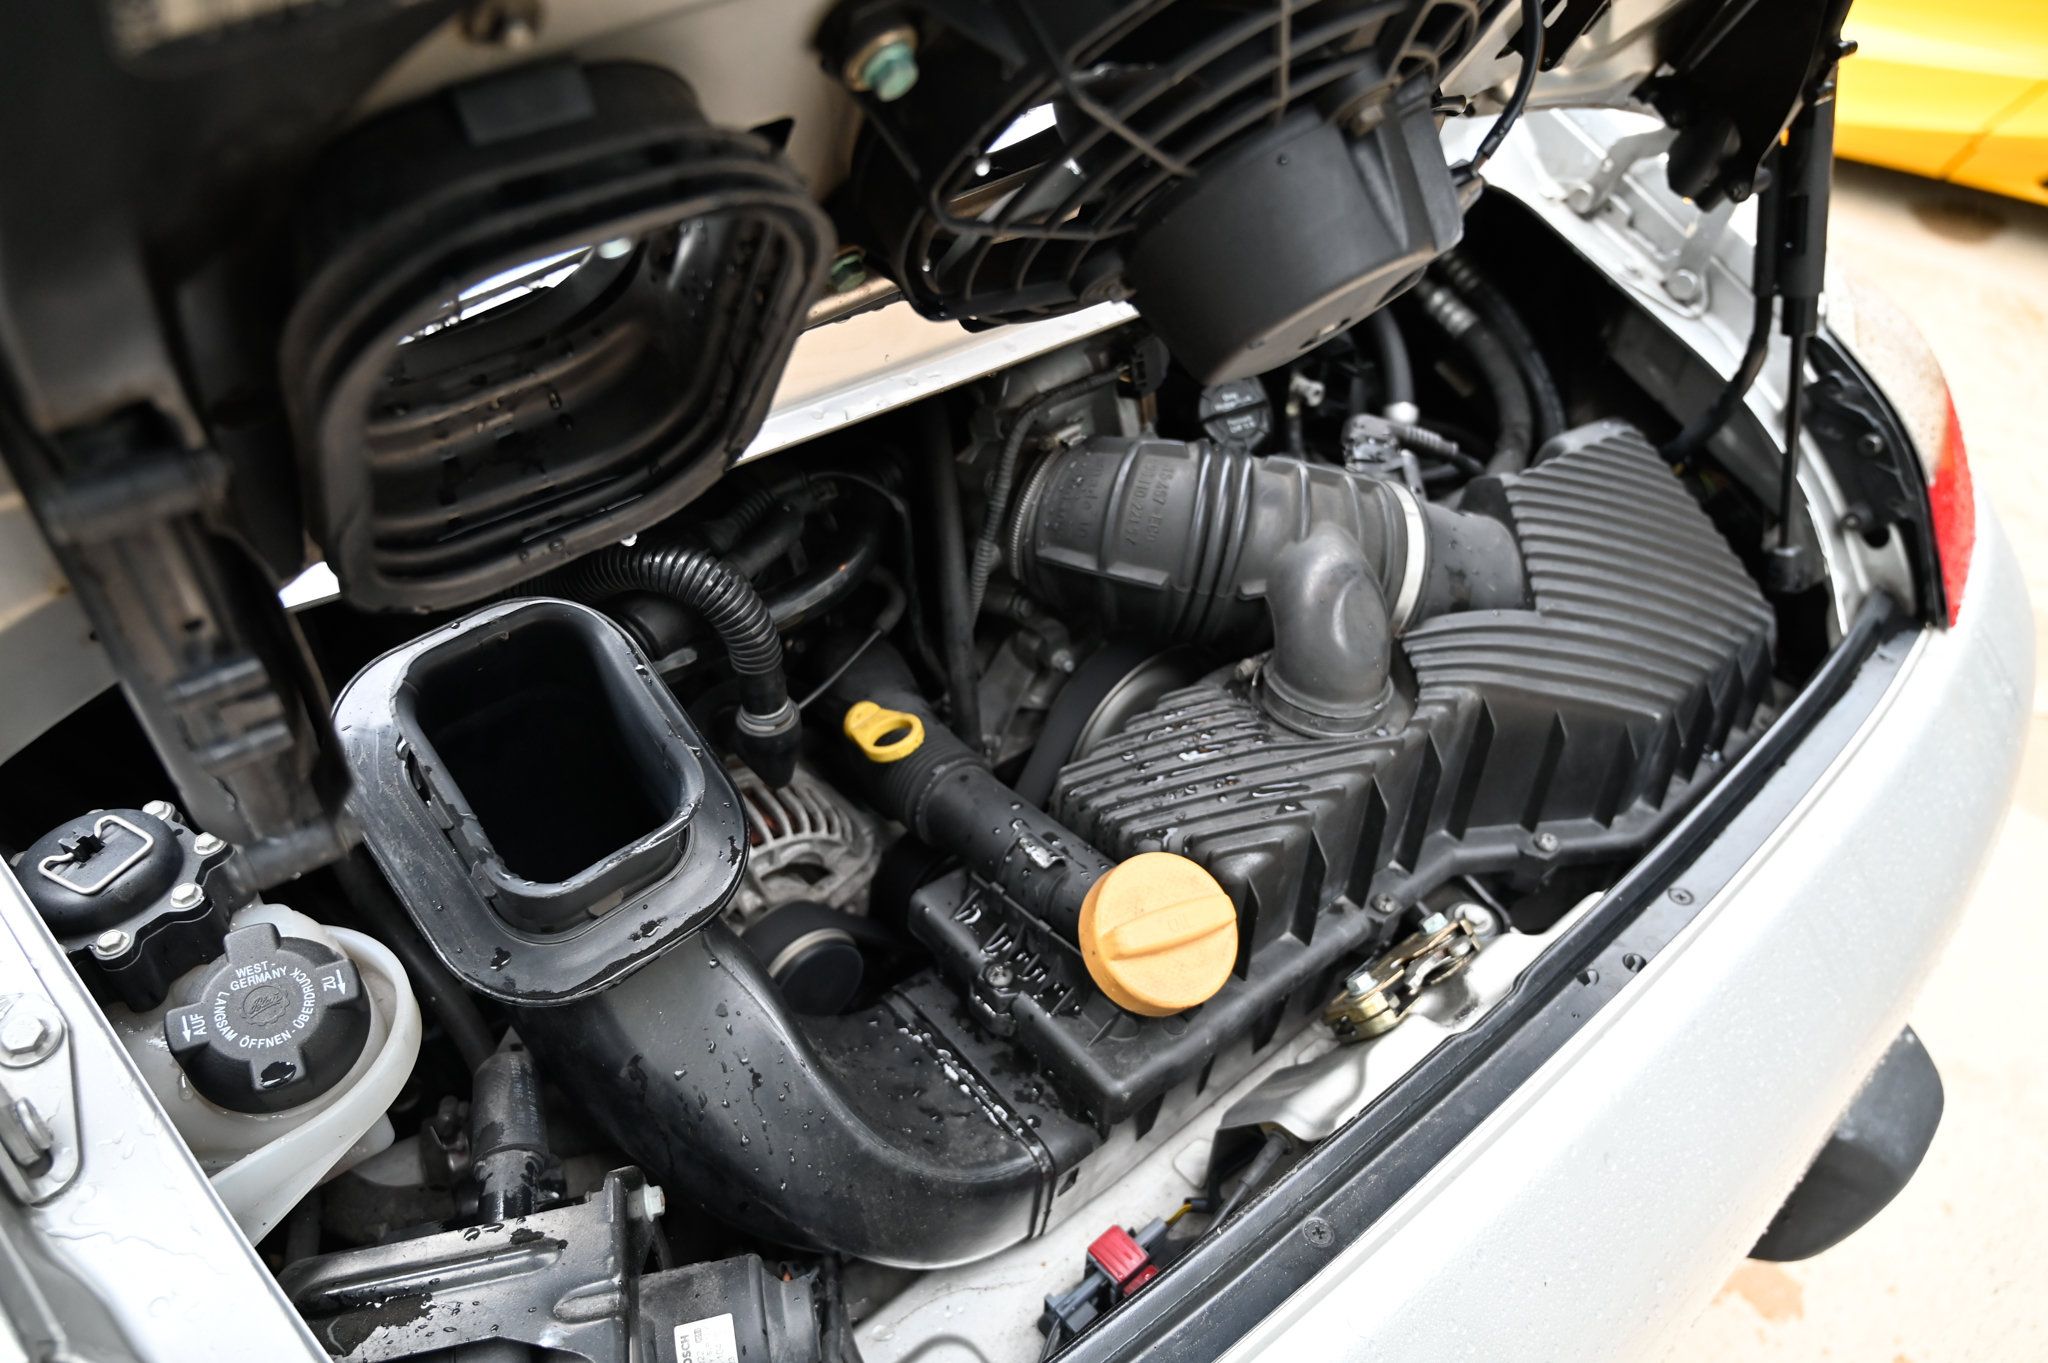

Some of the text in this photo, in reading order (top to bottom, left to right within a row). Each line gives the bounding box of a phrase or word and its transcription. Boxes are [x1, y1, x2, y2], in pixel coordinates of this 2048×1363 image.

[231, 966, 287, 991] GERMANY
[322, 976, 337, 991] ZU
[189, 1014, 207, 1035] AUF
[214, 991, 239, 1042] LANGSAM
